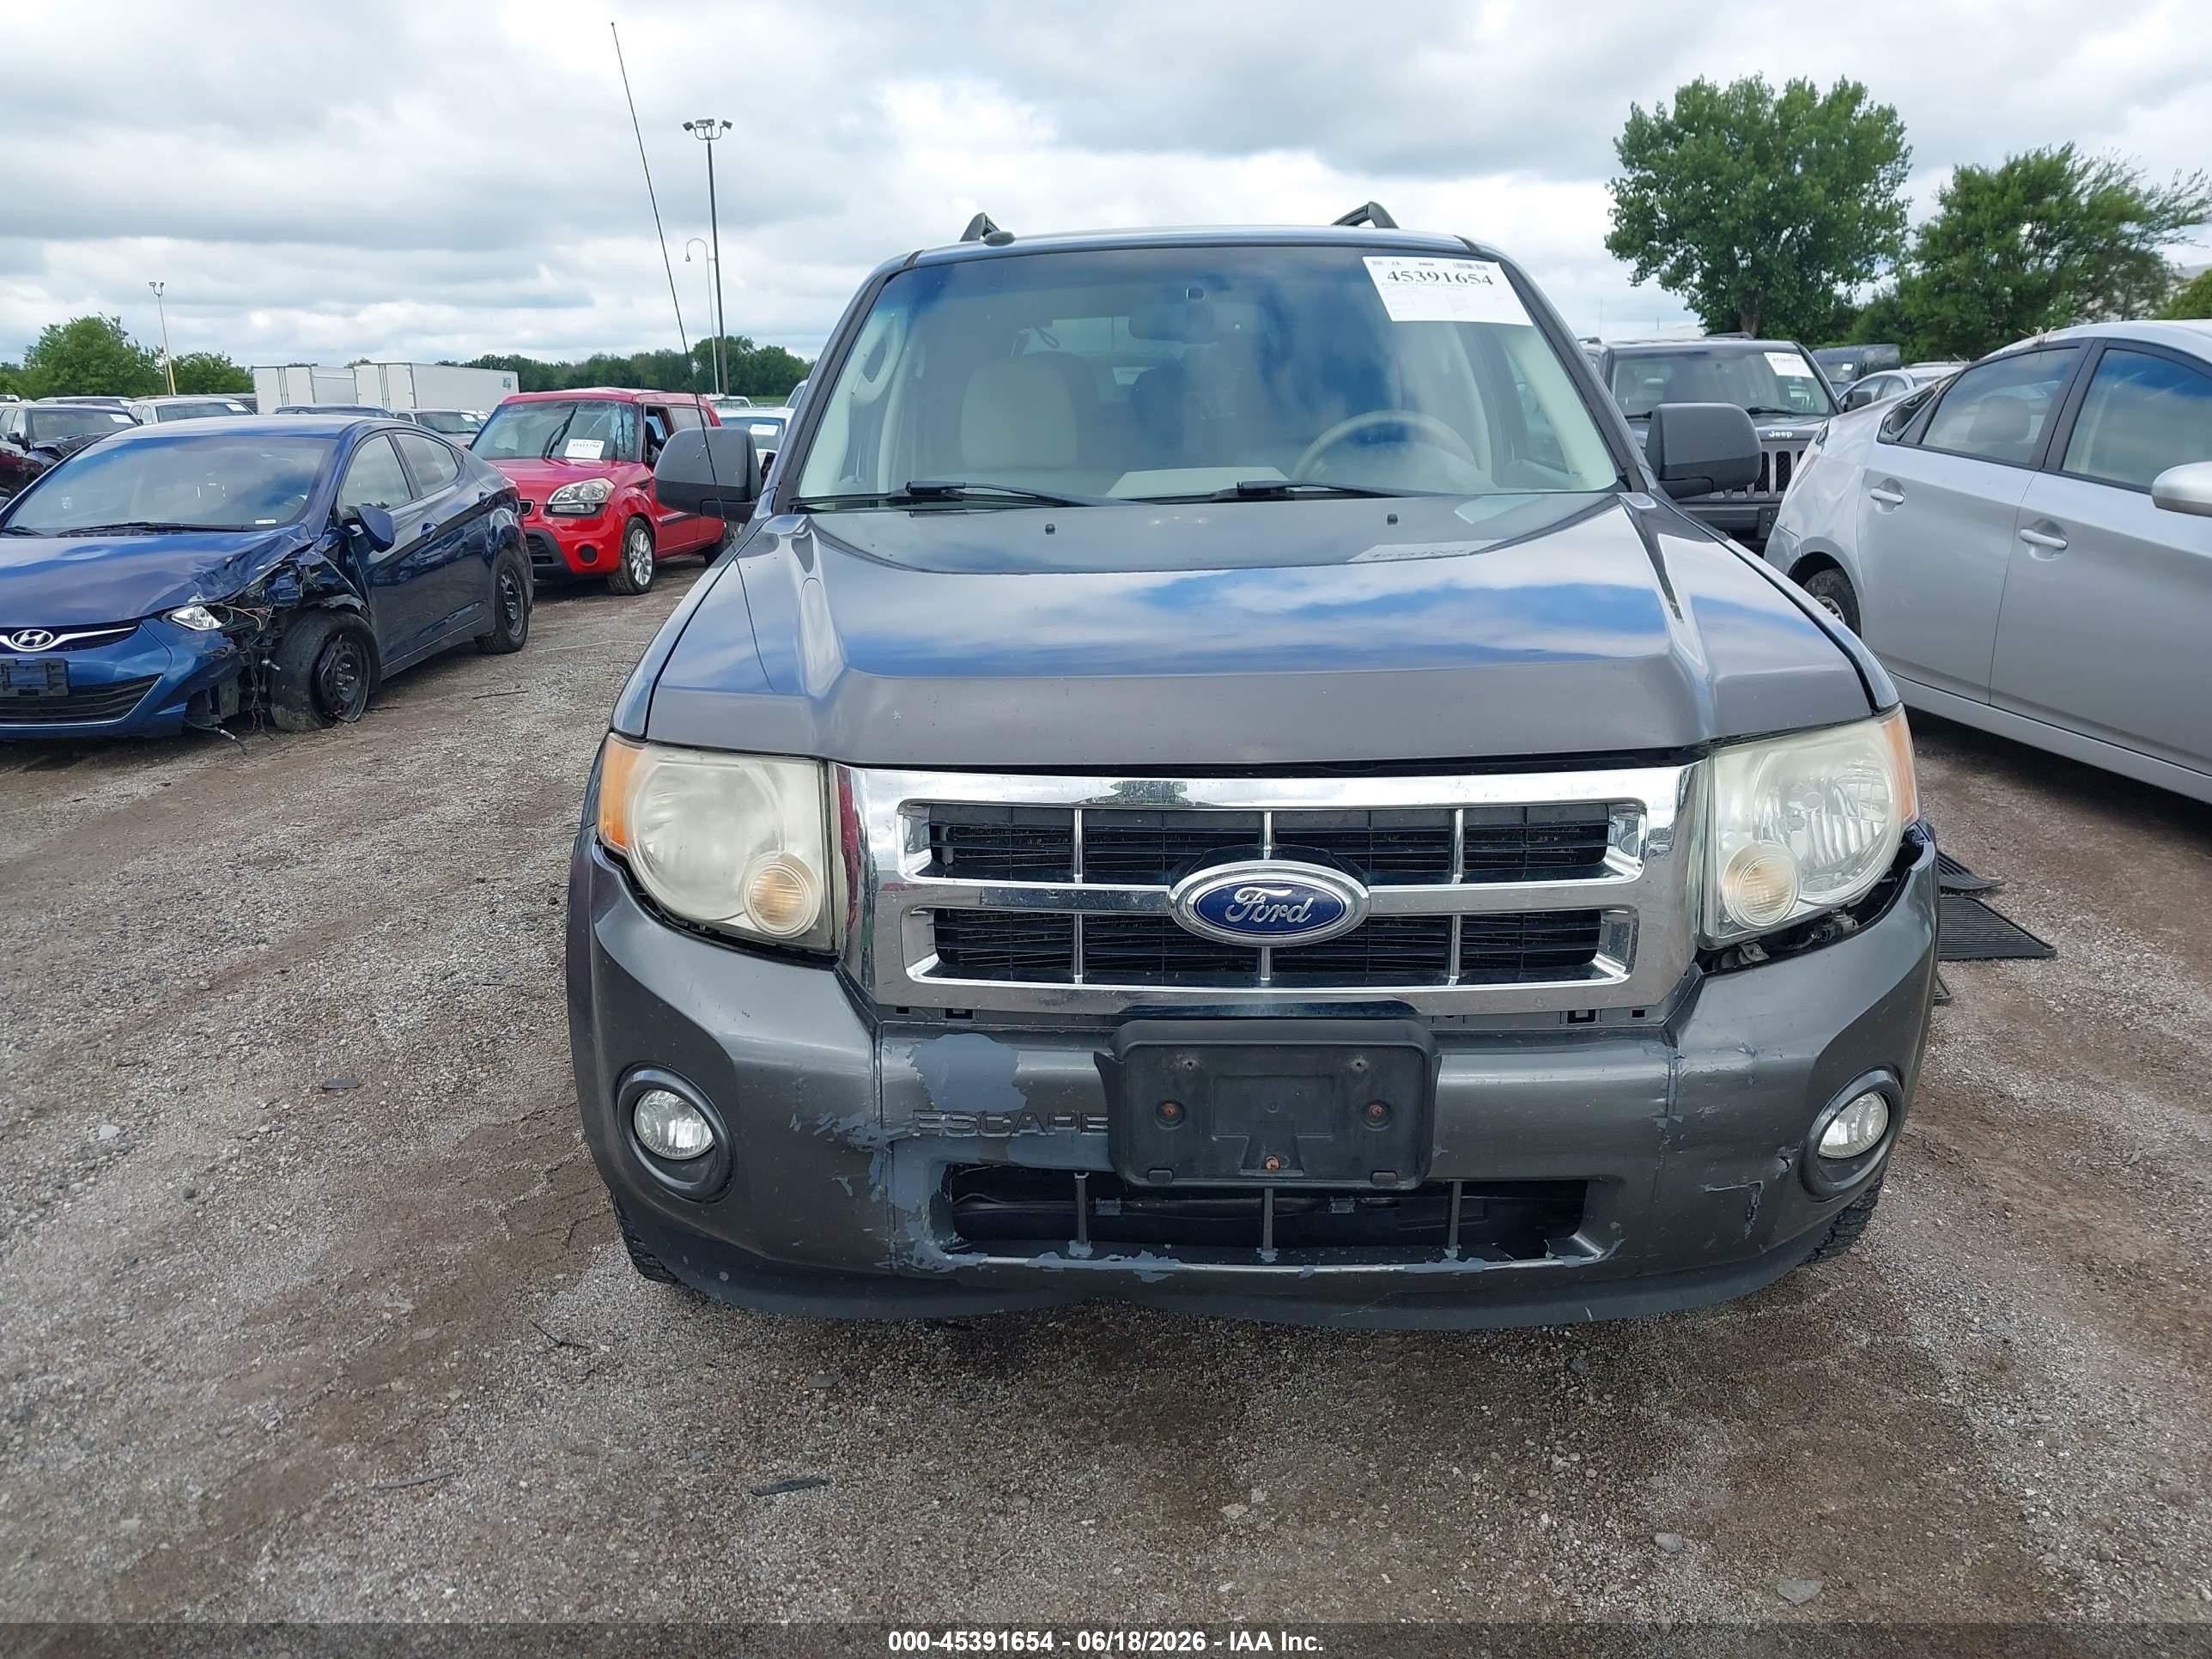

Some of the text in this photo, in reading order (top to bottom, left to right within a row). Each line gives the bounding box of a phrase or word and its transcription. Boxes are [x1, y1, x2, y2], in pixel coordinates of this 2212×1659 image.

[1388, 270, 1493, 285] 45391654
[1768, 430, 1793, 439] Jeep
[1224, 886, 1314, 923] Ford
[913, 1110, 1109, 1137] ESCAPE
